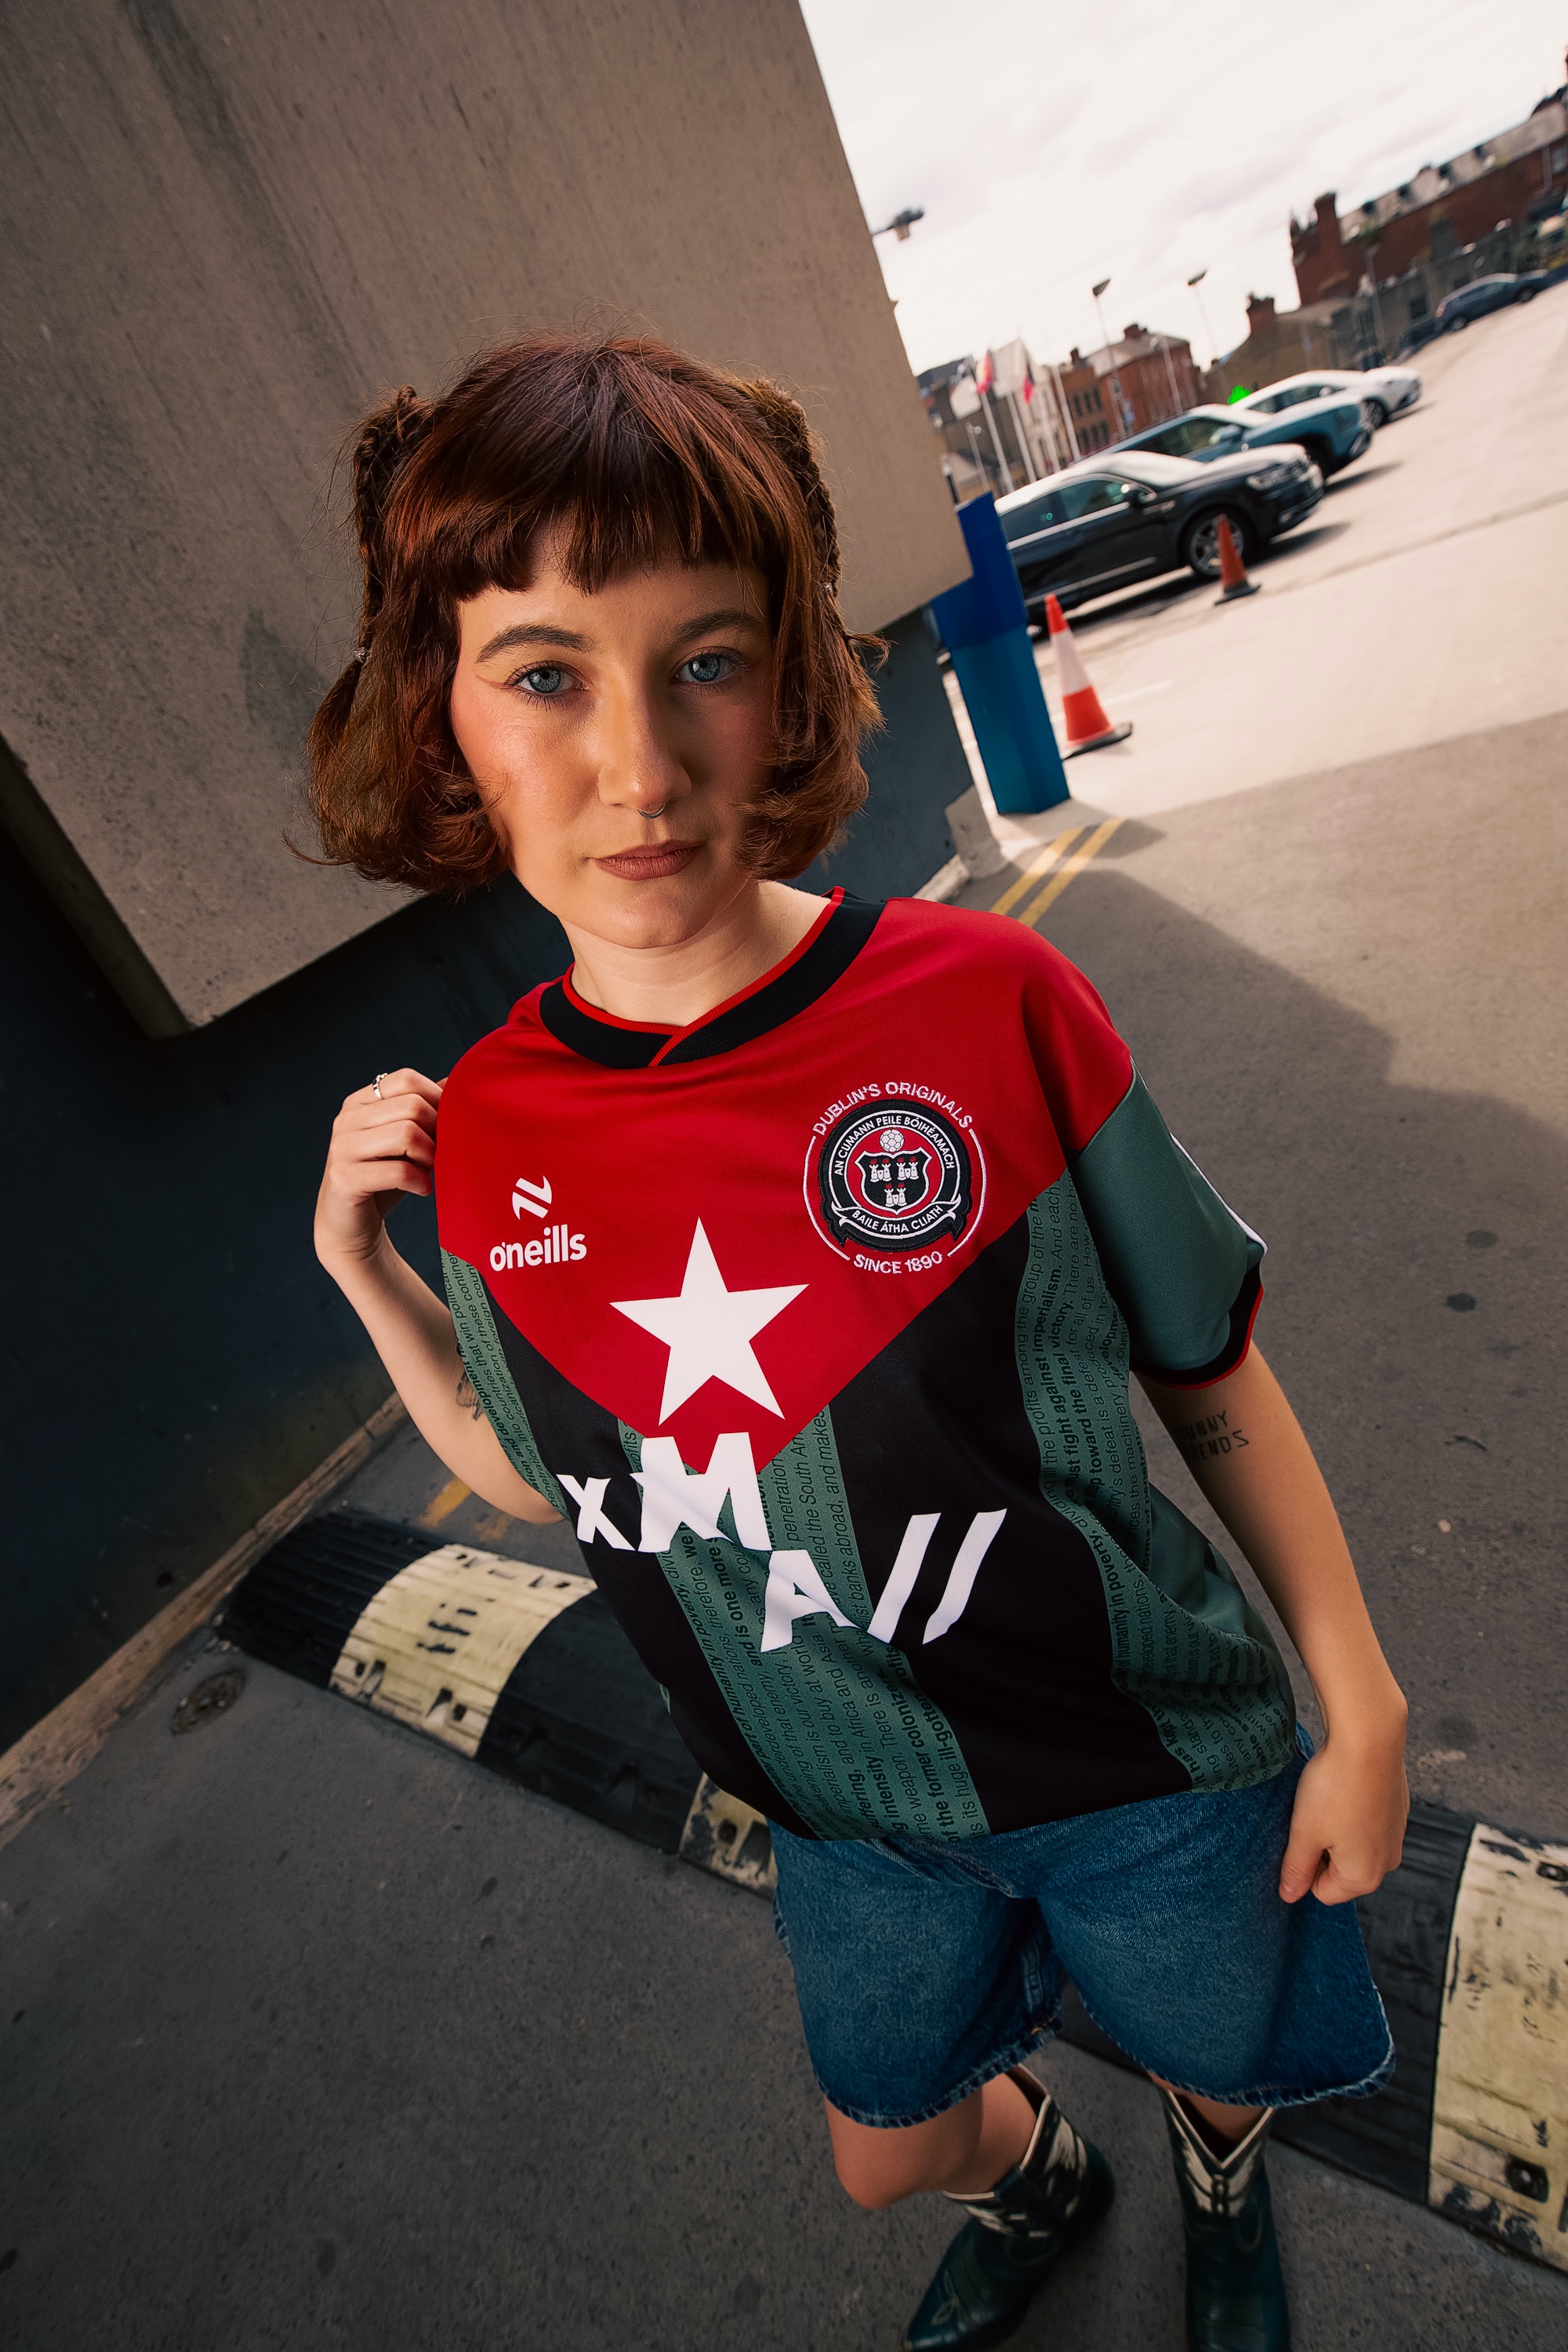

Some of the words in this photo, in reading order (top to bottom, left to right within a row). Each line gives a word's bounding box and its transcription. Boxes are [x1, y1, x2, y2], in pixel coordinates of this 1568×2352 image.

[812, 1083, 881, 1135] DUBLIN'S
[885, 1081, 973, 1128] ORIGINALS
[877, 1116, 902, 1126] PEILE
[838, 1121, 875, 1158] CUMANN
[834, 1160, 844, 1175] AN
[1045, 1187, 1060, 1223] each
[1069, 1202, 1078, 1221] no
[852, 1209, 879, 1230] BAILE
[880, 1221, 909, 1233] ÁTHA
[910, 1204, 944, 1229] CLIATH
[1031, 1216, 1044, 1240] the
[1051, 1229, 1063, 1260] And
[1069, 1226, 1078, 1250] are
[1083, 1235, 1092, 1267] How
[854, 1254, 902, 1274] SINCE
[905, 1250, 943, 1273] 1890
[1033, 1245, 1044, 1259] of
[1021, 1264, 1043, 1304] group
[1063, 1254, 1079, 1295] There
[1084, 1273, 1094, 1293] us.
[1032, 1265, 1062, 1352] imperialism.
[1082, 1297, 1093, 1310] of
[468, 1305, 487, 1337] these
[1016, 1307, 1029, 1330] the
[1048, 1301, 1073, 1348] victory.
[1073, 1312, 1087, 1326] all
[1092, 1314, 1105, 1323] in
[459, 1323, 474, 1342] win
[481, 1340, 494, 1351] of
[1065, 1327, 1078, 1345] for
[470, 1345, 487, 1367] that
[1018, 1334, 1033, 1385] among
[1053, 1353, 1076, 1385] final
[1084, 1327, 1115, 1388] produced
[1069, 1348, 1098, 1392] defeat
[483, 1370, 514, 1421] countries
[1036, 1356, 1066, 1414] against
[1025, 1390, 1055, 1436] profits
[1069, 1389, 1087, 1414] the
[1094, 1395, 1105, 1405] a
[1098, 1410, 1110, 1421] is
[512, 1423, 528, 1443] into
[1055, 1417, 1079, 1456] fight
[1110, 1392, 1136, 1469] machinery
[1041, 1440, 1057, 1464] the
[1077, 1418, 1102, 1474] toward
[1102, 1426, 1122, 1473] defeat
[524, 1445, 559, 1508] penetration
[793, 1462, 816, 1504] South
[818, 1465, 838, 1494] and
[1130, 1475, 1140, 1498] the
[771, 1458, 804, 1542] penetration
[804, 1510, 820, 1532] the
[681, 1537, 699, 1558] we
[808, 1536, 833, 1578] called
[709, 1545, 732, 1587] more
[1088, 1530, 1126, 1592] poverty,
[743, 1578, 763, 1604] any
[841, 1560, 864, 1600] banks
[690, 1562, 724, 1628] therefore,
[724, 1591, 743, 1621] one
[1109, 1593, 1123, 1606] in
[735, 1625, 750, 1637] is
[699, 1639, 715, 1652] in
[718, 1633, 751, 1680] nations,
[742, 1642, 763, 1666] and
[832, 1639, 873, 1688] another
[707, 1654, 746, 1716] humanity
[806, 1679, 823, 1693] at
[826, 1668, 851, 1697] and
[815, 1697, 834, 1721] buy
[866, 1693, 881, 1706] is
[777, 1718, 800, 1742] that
[797, 1708, 815, 1728] our
[826, 1725, 843, 1736] to
[841, 1700, 869, 1738] Africa
[873, 1711, 898, 1748] There
[1244, 1712, 1267, 1735] with
[739, 1683, 798, 1782] underdeveloped
[808, 1731, 820, 1741] is
[1210, 1730, 1223, 1744] to
[834, 1740, 855, 1765] and
[854, 1742, 874, 1752] in
[1174, 1746, 1200, 1772] has
[1233, 1738, 1251, 1761] any
[863, 1755, 902, 1819] intensity
[914, 1751, 943, 1797] former
[947, 1764, 970, 1797] huge
[931, 1801, 955, 1827] the
[962, 1801, 979, 1819] its
